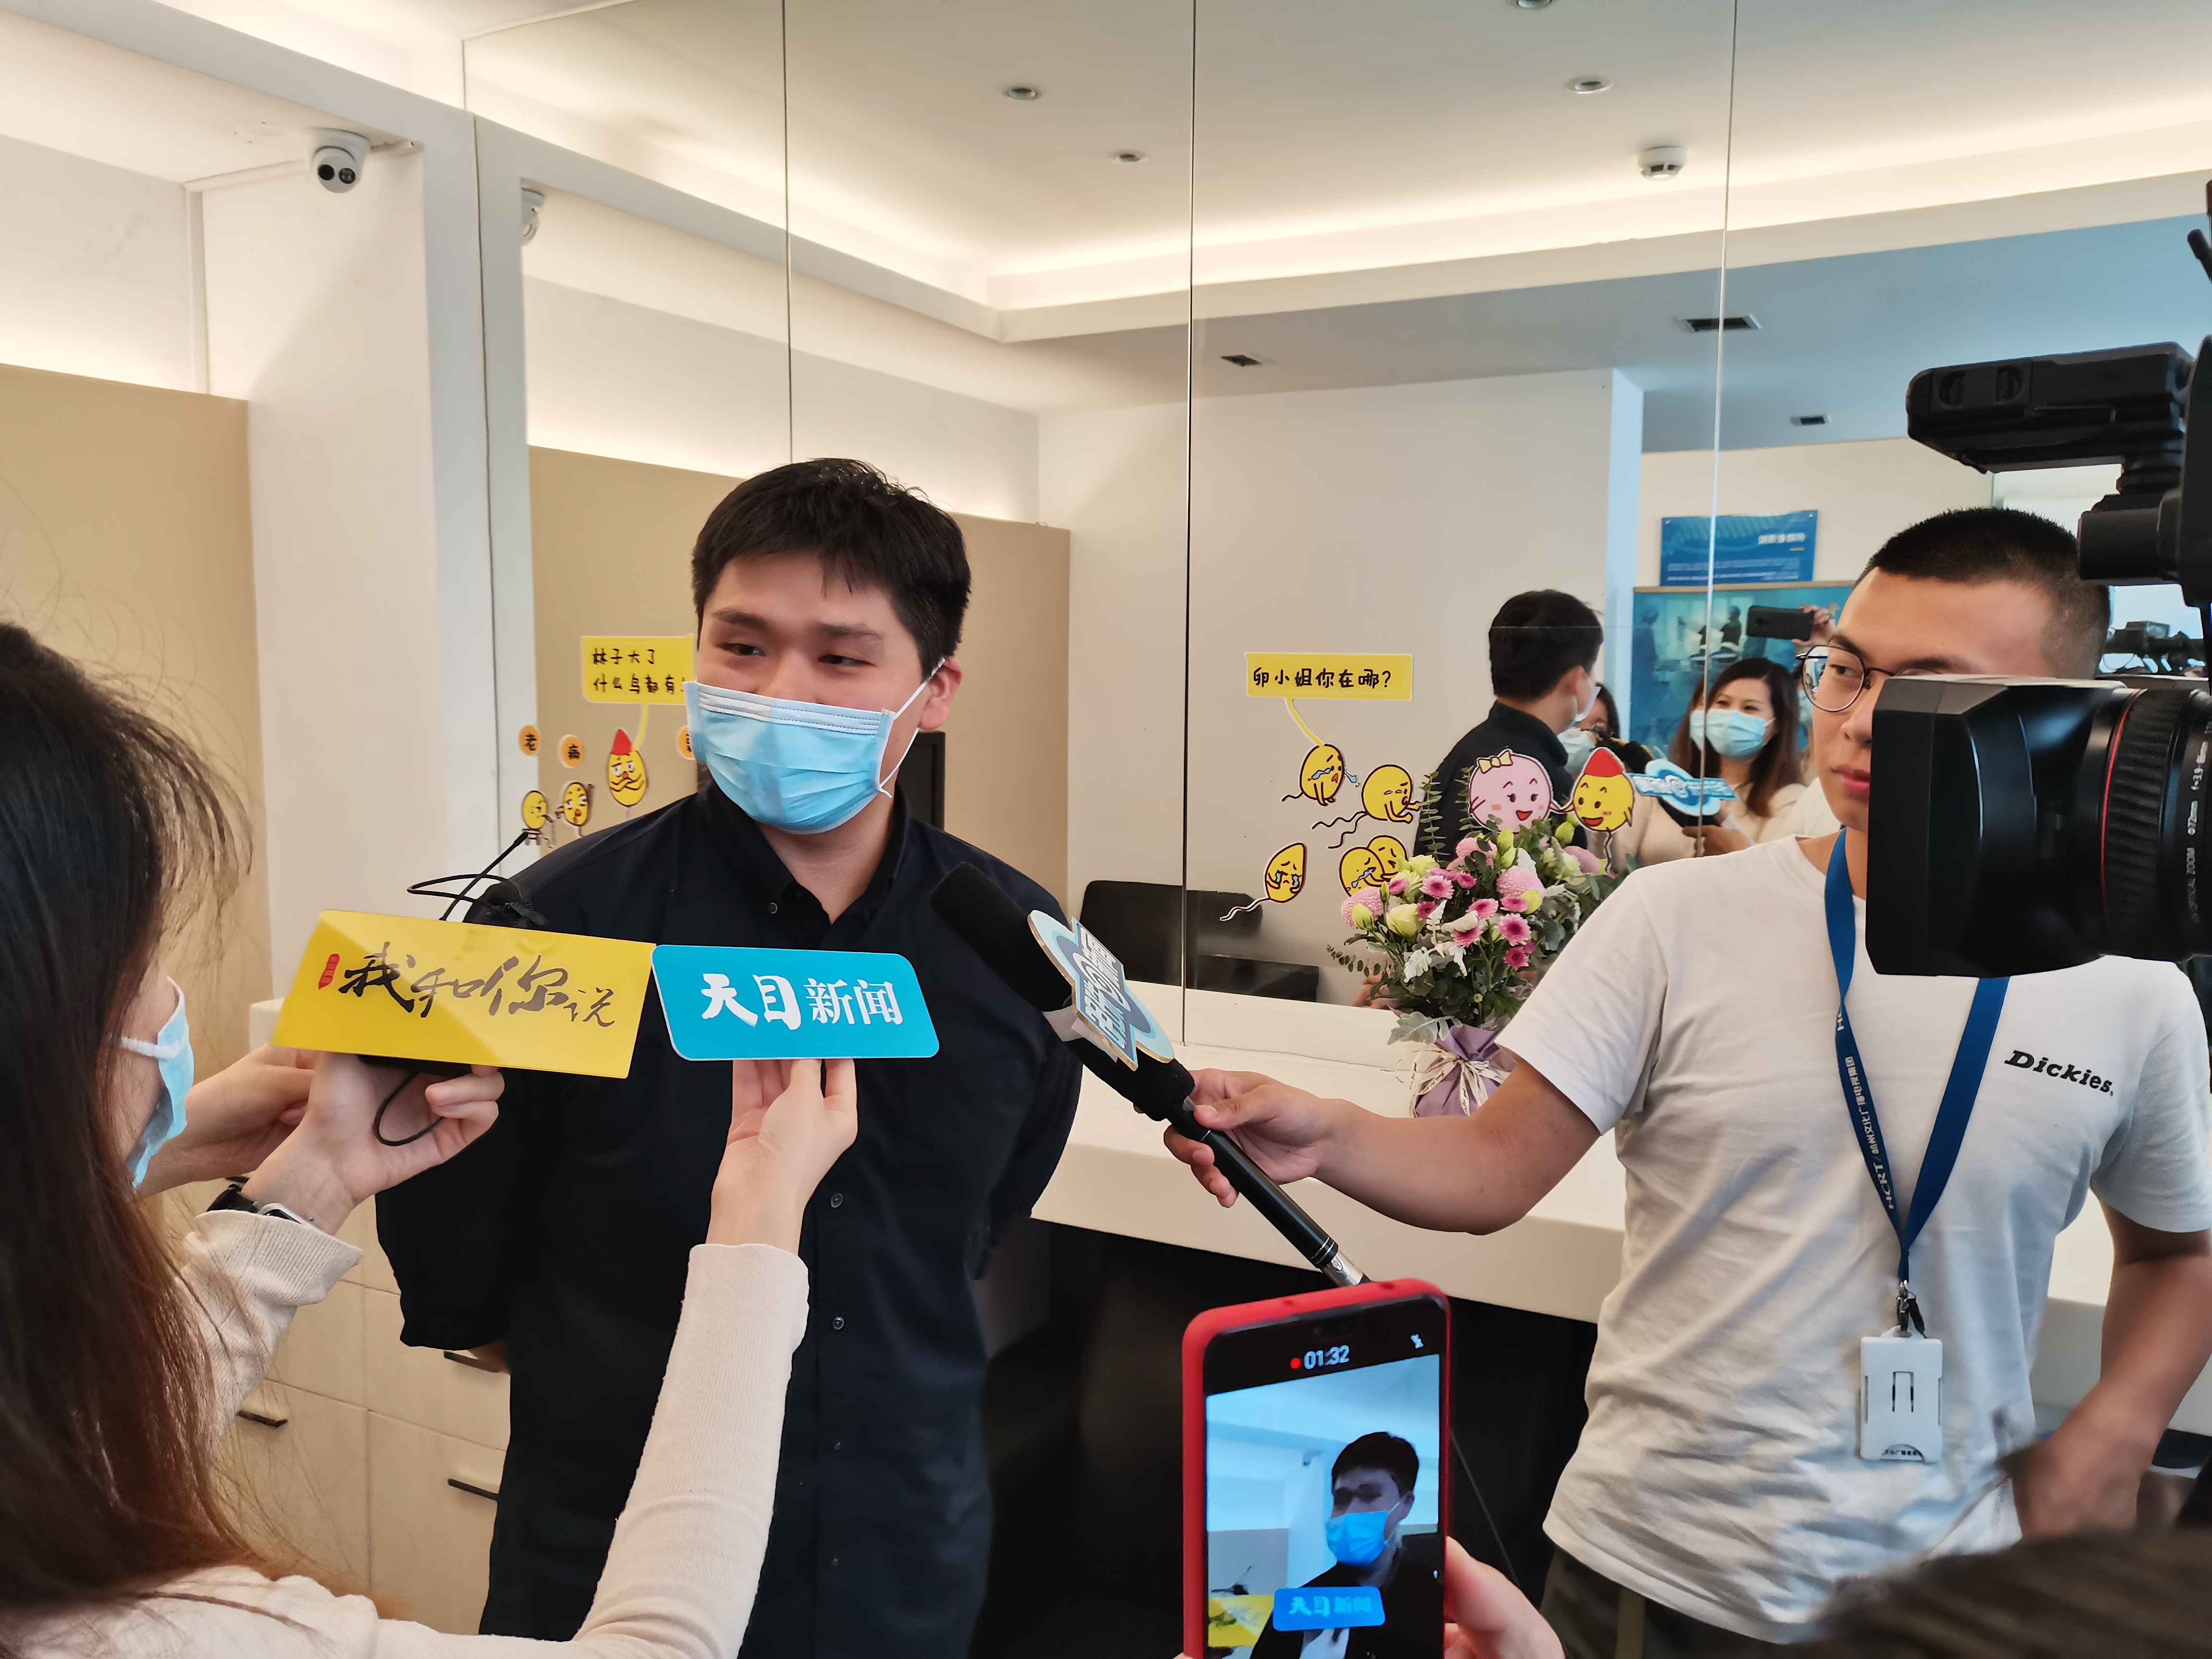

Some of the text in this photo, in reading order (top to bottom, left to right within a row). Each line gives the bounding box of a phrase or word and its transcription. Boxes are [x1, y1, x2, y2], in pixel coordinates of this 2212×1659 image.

[1253, 667, 1392, 689] 卵小姐你在哪?
[337, 941, 615, 1028] 我和你说
[700, 973, 903, 1031] 天目新闻
[1303, 1345, 1350, 1370] 01:32
